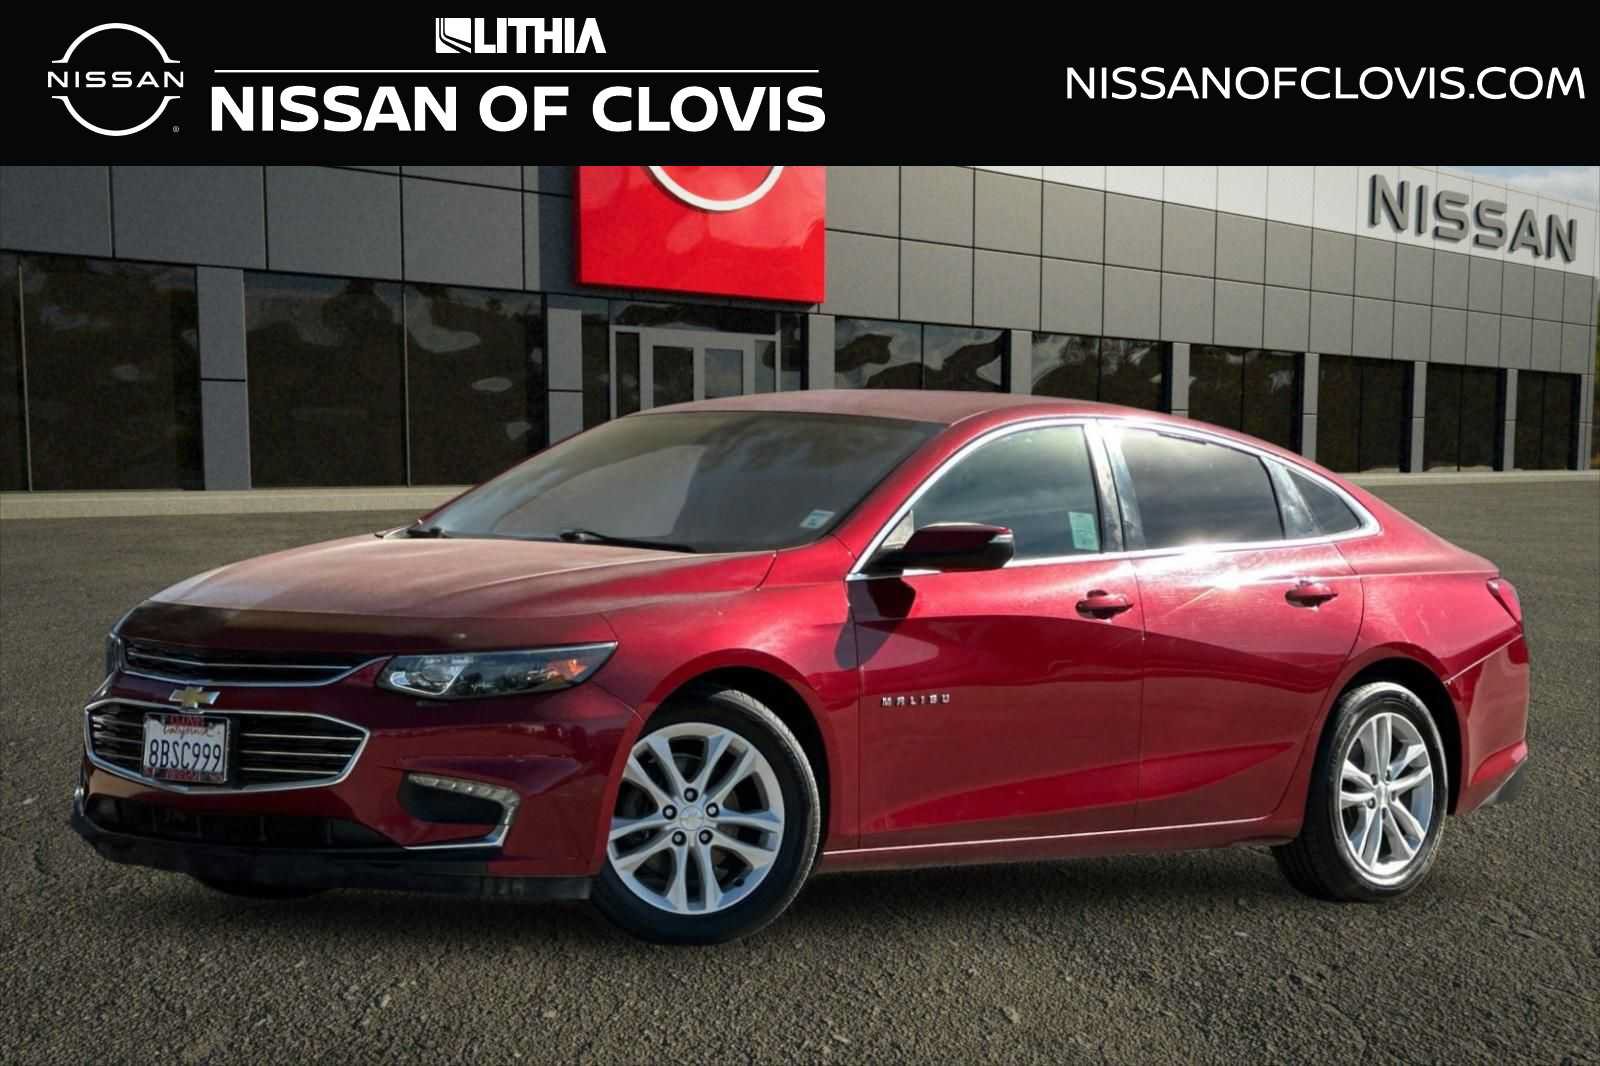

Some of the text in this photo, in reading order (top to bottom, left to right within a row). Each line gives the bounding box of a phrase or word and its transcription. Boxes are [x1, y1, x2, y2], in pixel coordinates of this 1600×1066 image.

[1368, 174, 1577, 263] NISSAN
[881, 693, 951, 708] MALIBU
[148, 738, 222, 772] 8BSC999
